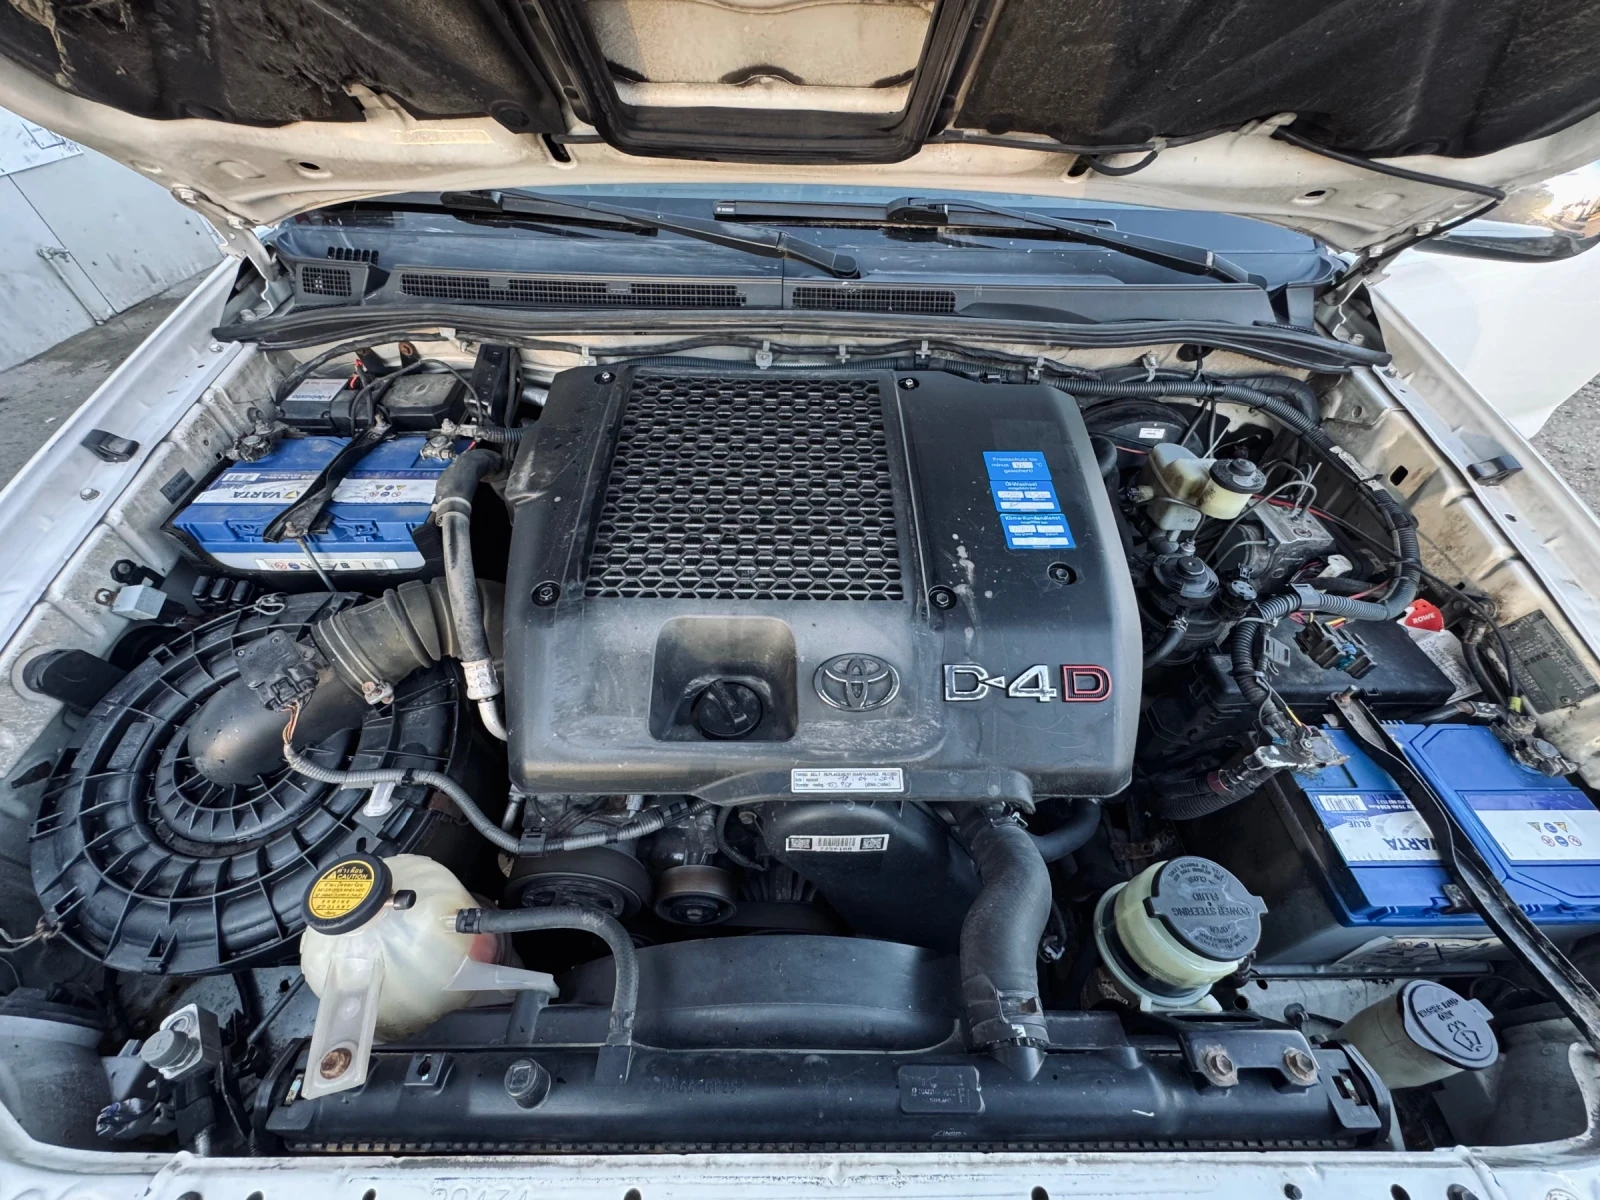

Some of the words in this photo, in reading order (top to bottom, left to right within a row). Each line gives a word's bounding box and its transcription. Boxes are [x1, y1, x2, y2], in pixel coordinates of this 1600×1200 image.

[232, 491, 281, 499] VARTA
[1412, 612, 1435, 624] ROWE
[1347, 820, 1371, 828] BLUE
[1192, 892, 1219, 901] FLUID
[1171, 907, 1217, 916] STEERING
[1217, 907, 1250, 917] POWER
